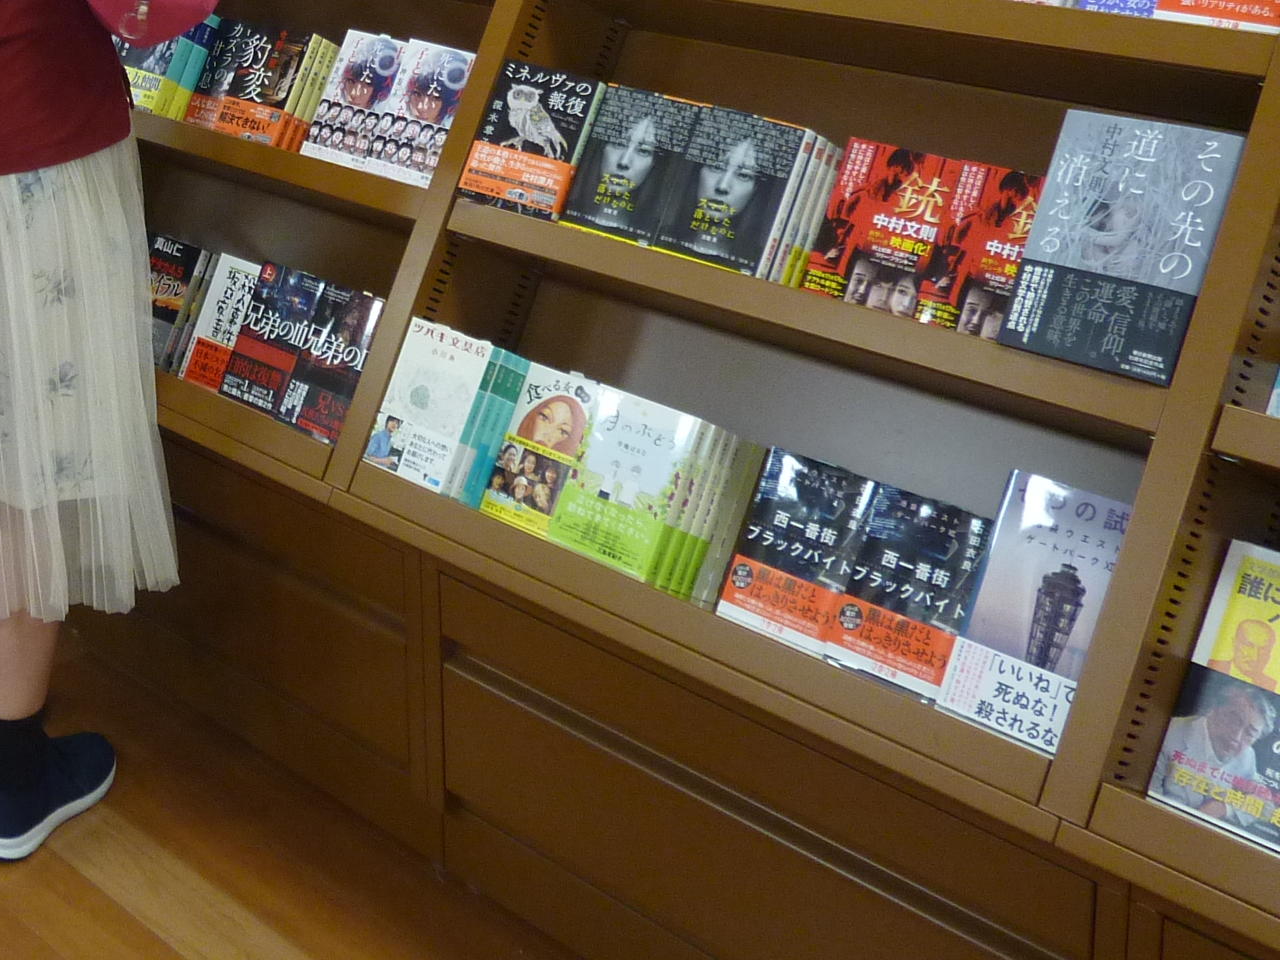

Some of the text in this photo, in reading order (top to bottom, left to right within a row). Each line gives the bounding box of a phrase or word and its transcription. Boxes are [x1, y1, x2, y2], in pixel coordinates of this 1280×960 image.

[237, 34, 272, 103] 豹変
[505, 63, 593, 96] ミネルヴァの
[547, 90, 588, 118] 報復
[1088, 122, 1124, 195] 中村文則
[1122, 129, 1164, 195] 道に
[893, 171, 951, 225] 銃
[1039, 153, 1092, 253] 消える
[1158, 140, 1223, 280] その先の
[872, 213, 939, 243] 中村文則
[888, 235, 931, 257] 映画化!
[984, 239, 1024, 262] 中村
[211, 269, 241, 338] 坂口安吾
[1100, 285, 1139, 363] 愛、信仰、
[412, 322, 487, 358] ツバキ文具店
[747, 525, 852, 576] ブラックバイト
[773, 510, 838, 548] 西一番街
[757, 567, 818, 604] 黒は黒だと
[881, 549, 951, 589] 西一番街
[853, 565, 965, 620] ブラックバイト
[867, 607, 933, 647] 黒は黒だと
[974, 700, 1058, 747] 殺されるな
[992, 681, 1058, 723] 死ぬな!
